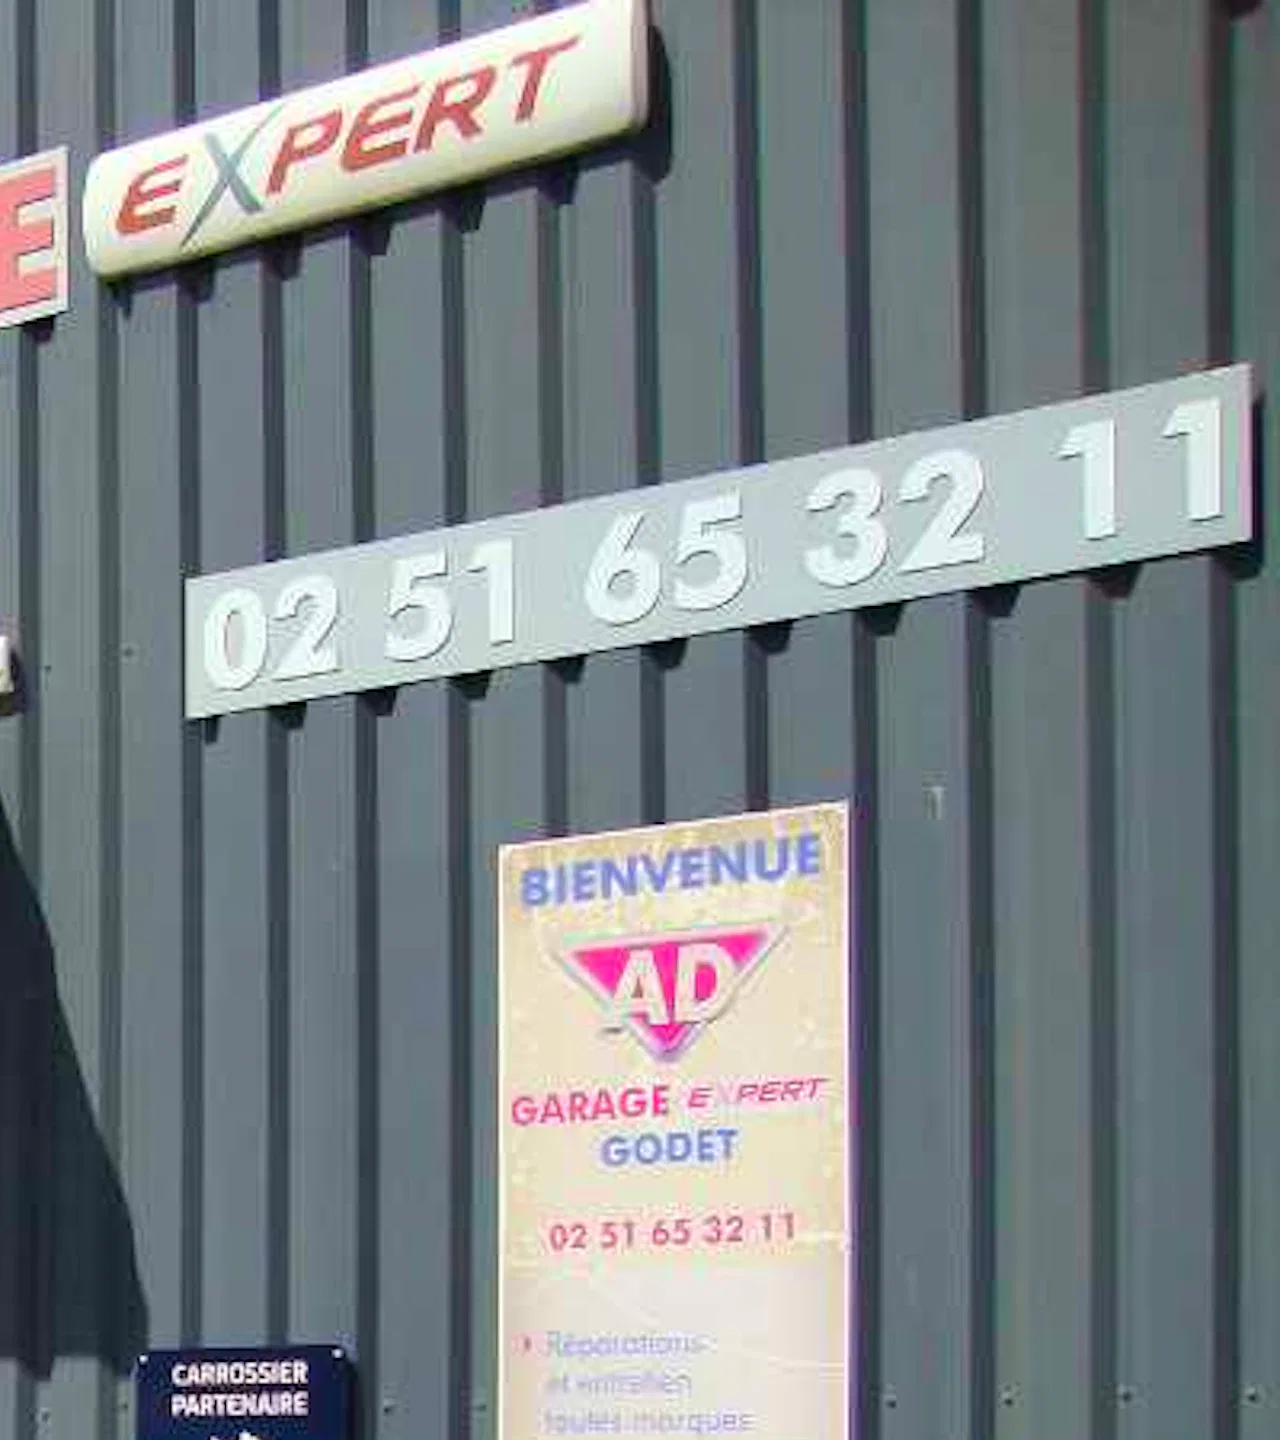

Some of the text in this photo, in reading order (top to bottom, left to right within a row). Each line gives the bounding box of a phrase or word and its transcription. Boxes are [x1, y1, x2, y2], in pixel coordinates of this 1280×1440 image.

[202, 397, 1225, 692] 02 51 65 32 11
[520, 832, 821, 908] BIENVENUE
[597, 942, 741, 1032] AD
[511, 1078, 831, 1126] GARAGE EPERT
[601, 1129, 739, 1167] GODET
[549, 1212, 796, 1251] 02 51 65 32 11
[171, 1362, 309, 1385] CARROSSIER
[171, 1391, 309, 1417] PARTENAIRE
